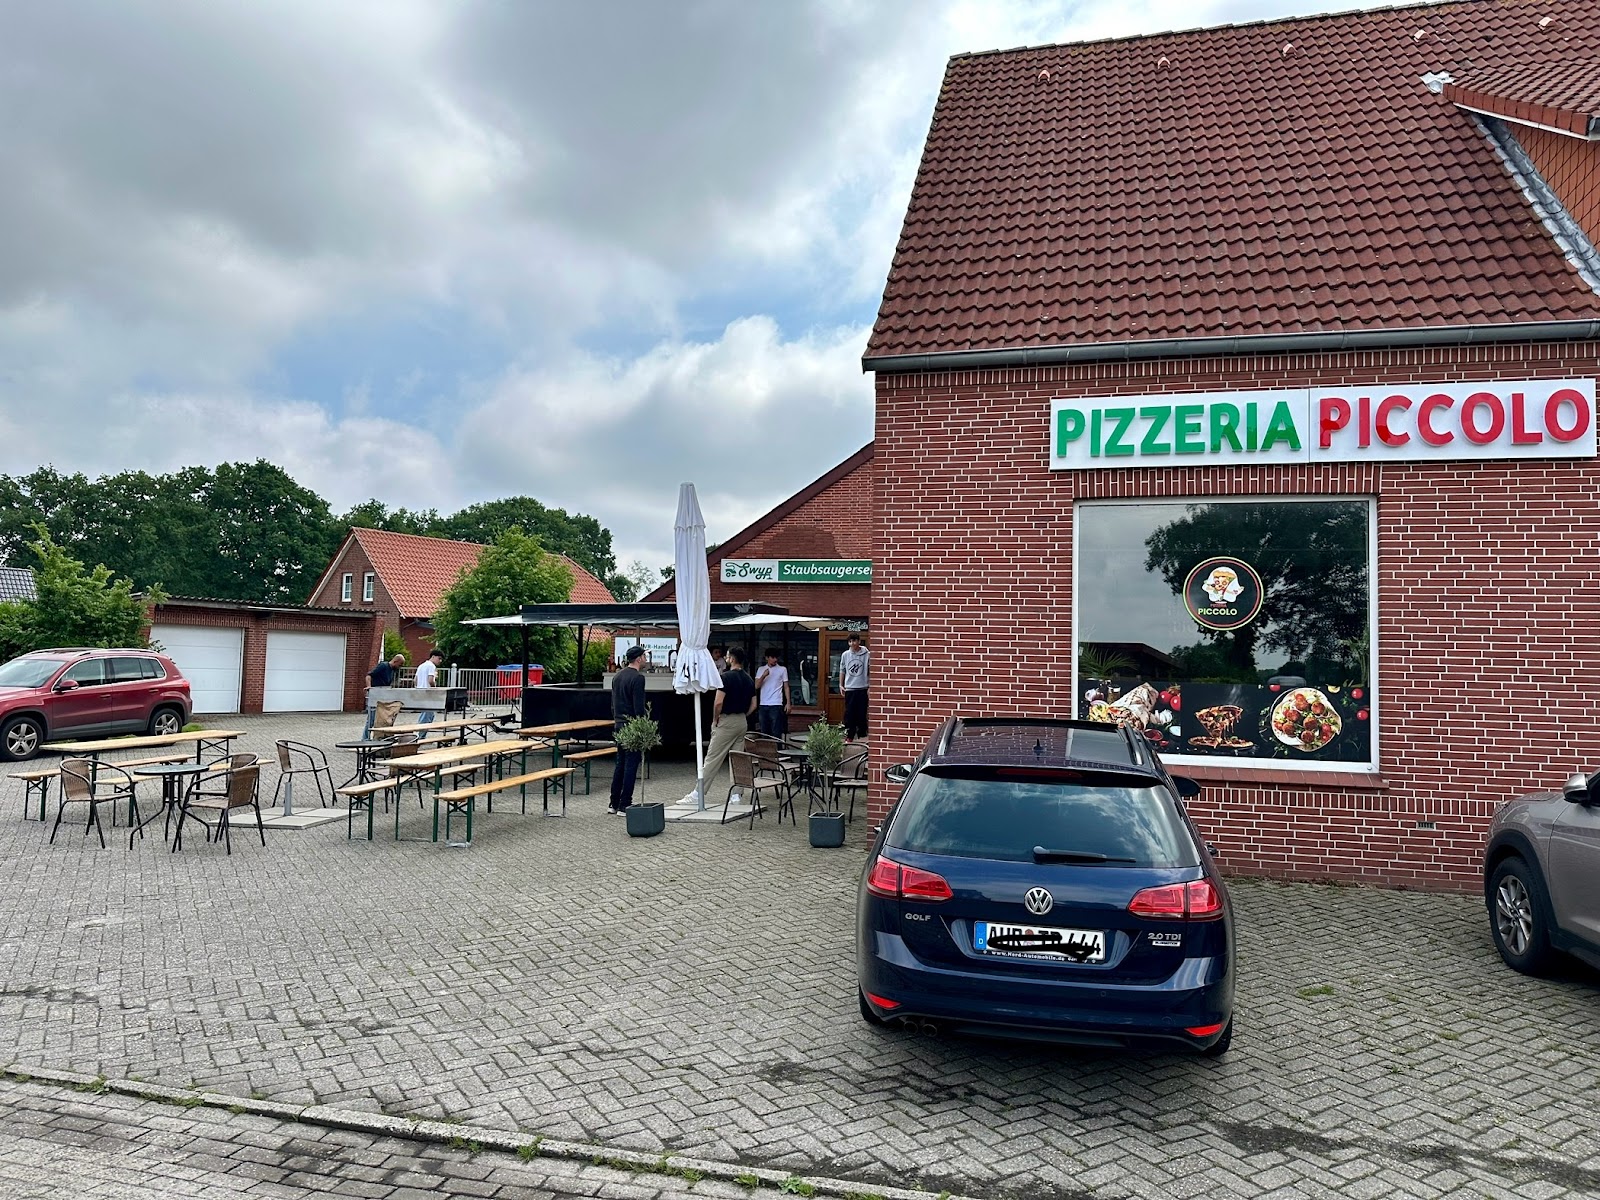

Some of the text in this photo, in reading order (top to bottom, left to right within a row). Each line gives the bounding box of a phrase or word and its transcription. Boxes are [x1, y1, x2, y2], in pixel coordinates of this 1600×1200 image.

[1056, 388, 1590, 458] PIZZERIA PICCOLO
[1197, 607, 1238, 616] PICCOLO
[904, 912, 932, 922] GOLF
[1164, 933, 1182, 941] TDI
